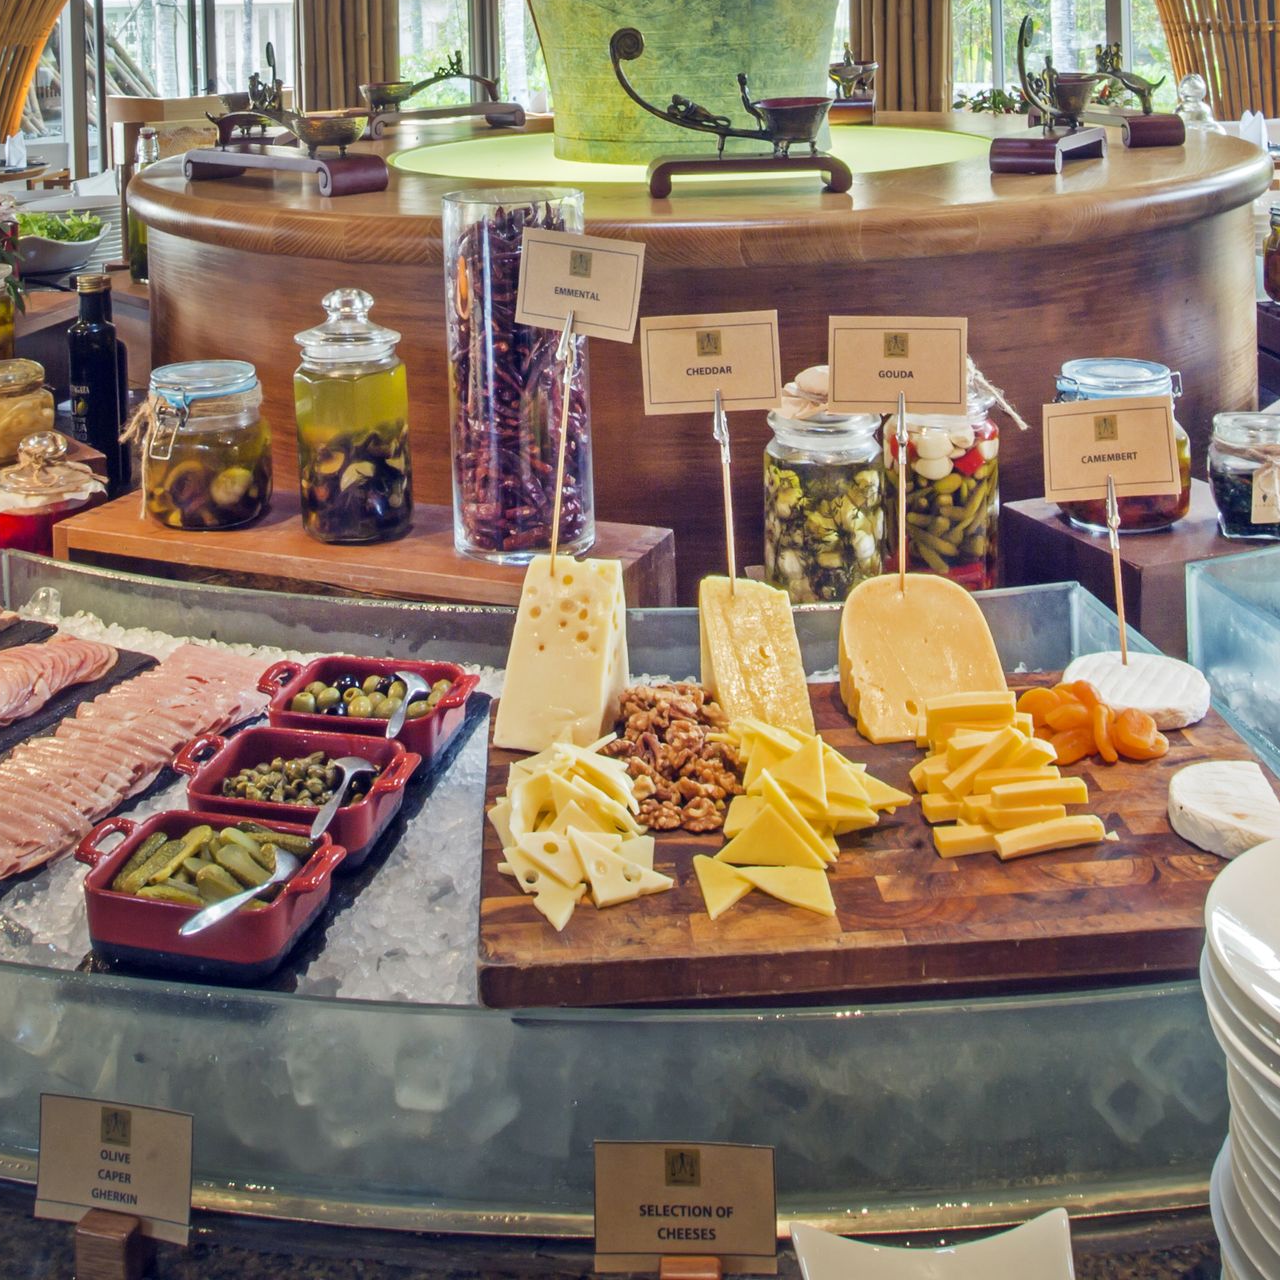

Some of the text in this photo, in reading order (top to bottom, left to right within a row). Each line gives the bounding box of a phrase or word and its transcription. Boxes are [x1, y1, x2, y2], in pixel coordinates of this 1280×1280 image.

[554, 286, 601, 301] EMMENTAL
[686, 365, 733, 376] CHEDDAR
[878, 370, 914, 379] GOUDA
[1081, 451, 1138, 464] CAMEMBERT
[100, 1149, 131, 1164] OLIVE
[97, 1169, 132, 1184] CAPER
[91, 1187, 138, 1205] GHERKIN
[639, 1204, 734, 1218] SELECTION OF
[657, 1227, 716, 1240] CHEESES
